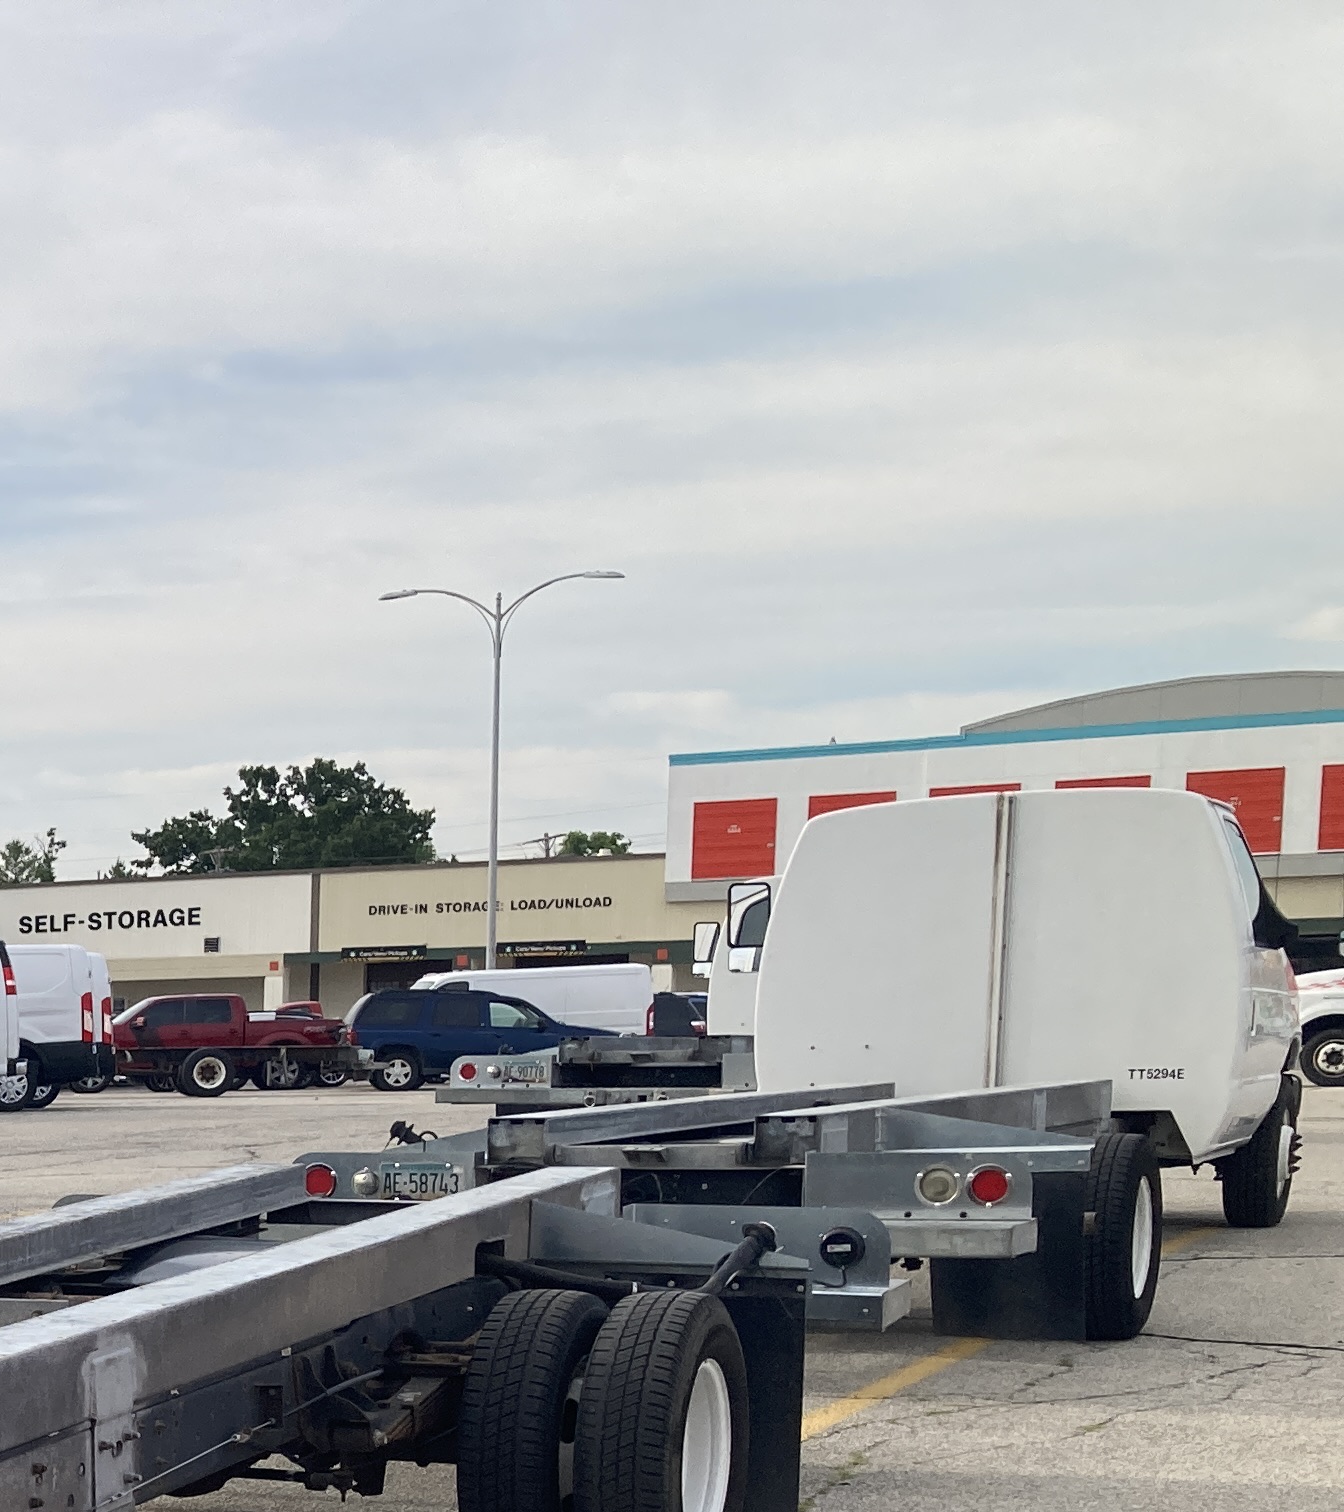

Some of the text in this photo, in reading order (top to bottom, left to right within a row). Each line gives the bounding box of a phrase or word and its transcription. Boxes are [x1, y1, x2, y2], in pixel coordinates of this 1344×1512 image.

[368, 903, 429, 916] DRIVE-IN
[510, 896, 613, 912] LOAD/UNLOAD
[19, 906, 202, 935] SELF-STORAGE
[1127, 1068, 1185, 1080] TT5294E
